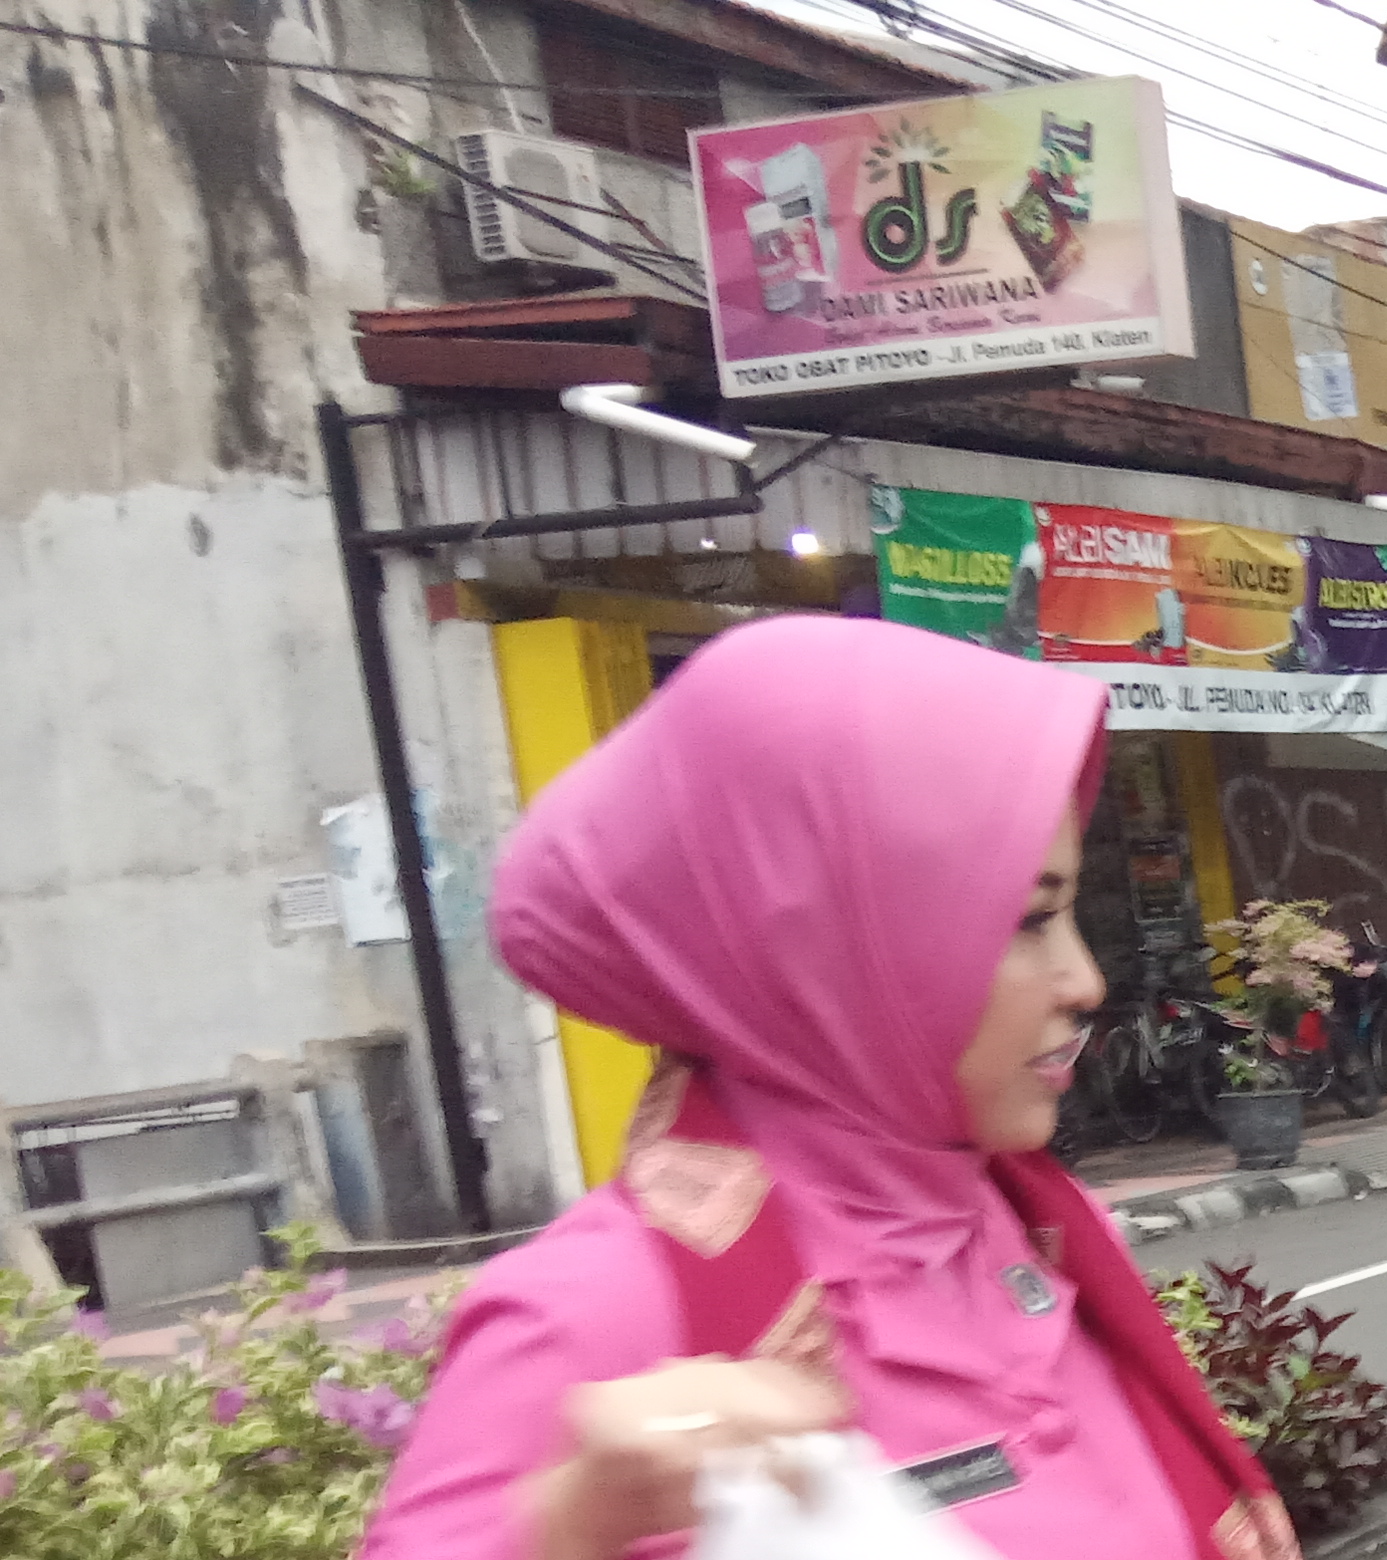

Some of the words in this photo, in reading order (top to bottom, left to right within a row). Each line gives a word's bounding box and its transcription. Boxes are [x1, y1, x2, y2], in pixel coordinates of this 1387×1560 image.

[863, 161, 977, 273] ds
[733, 363, 789, 386] TOKO
[796, 355, 850, 379] OBAT
[855, 347, 931, 373] PITOYO
[972, 336, 1045, 360] Pemuda
[1092, 329, 1152, 348] Klaten
